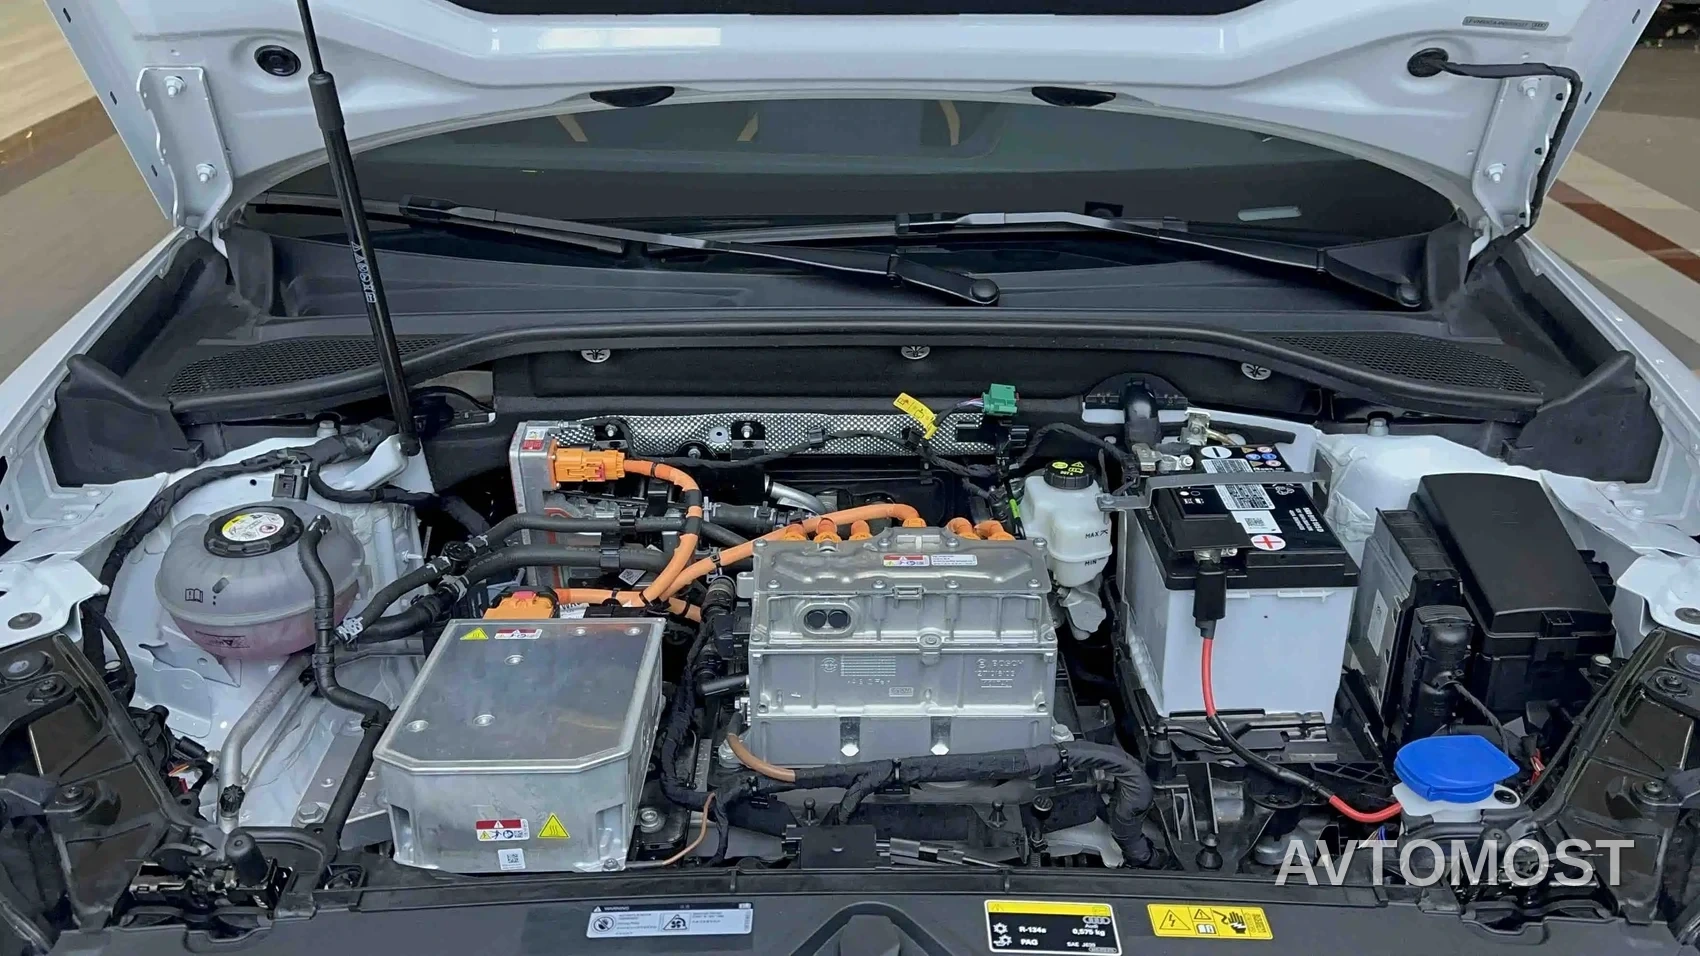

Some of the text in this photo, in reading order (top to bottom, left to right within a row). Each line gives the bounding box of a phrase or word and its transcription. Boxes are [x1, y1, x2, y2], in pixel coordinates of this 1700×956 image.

[1085, 530, 1099, 539] MAX
[1018, 926, 1047, 934] R-134a
[1094, 929, 1106, 937] kg
[1020, 938, 1039, 946] PAG
